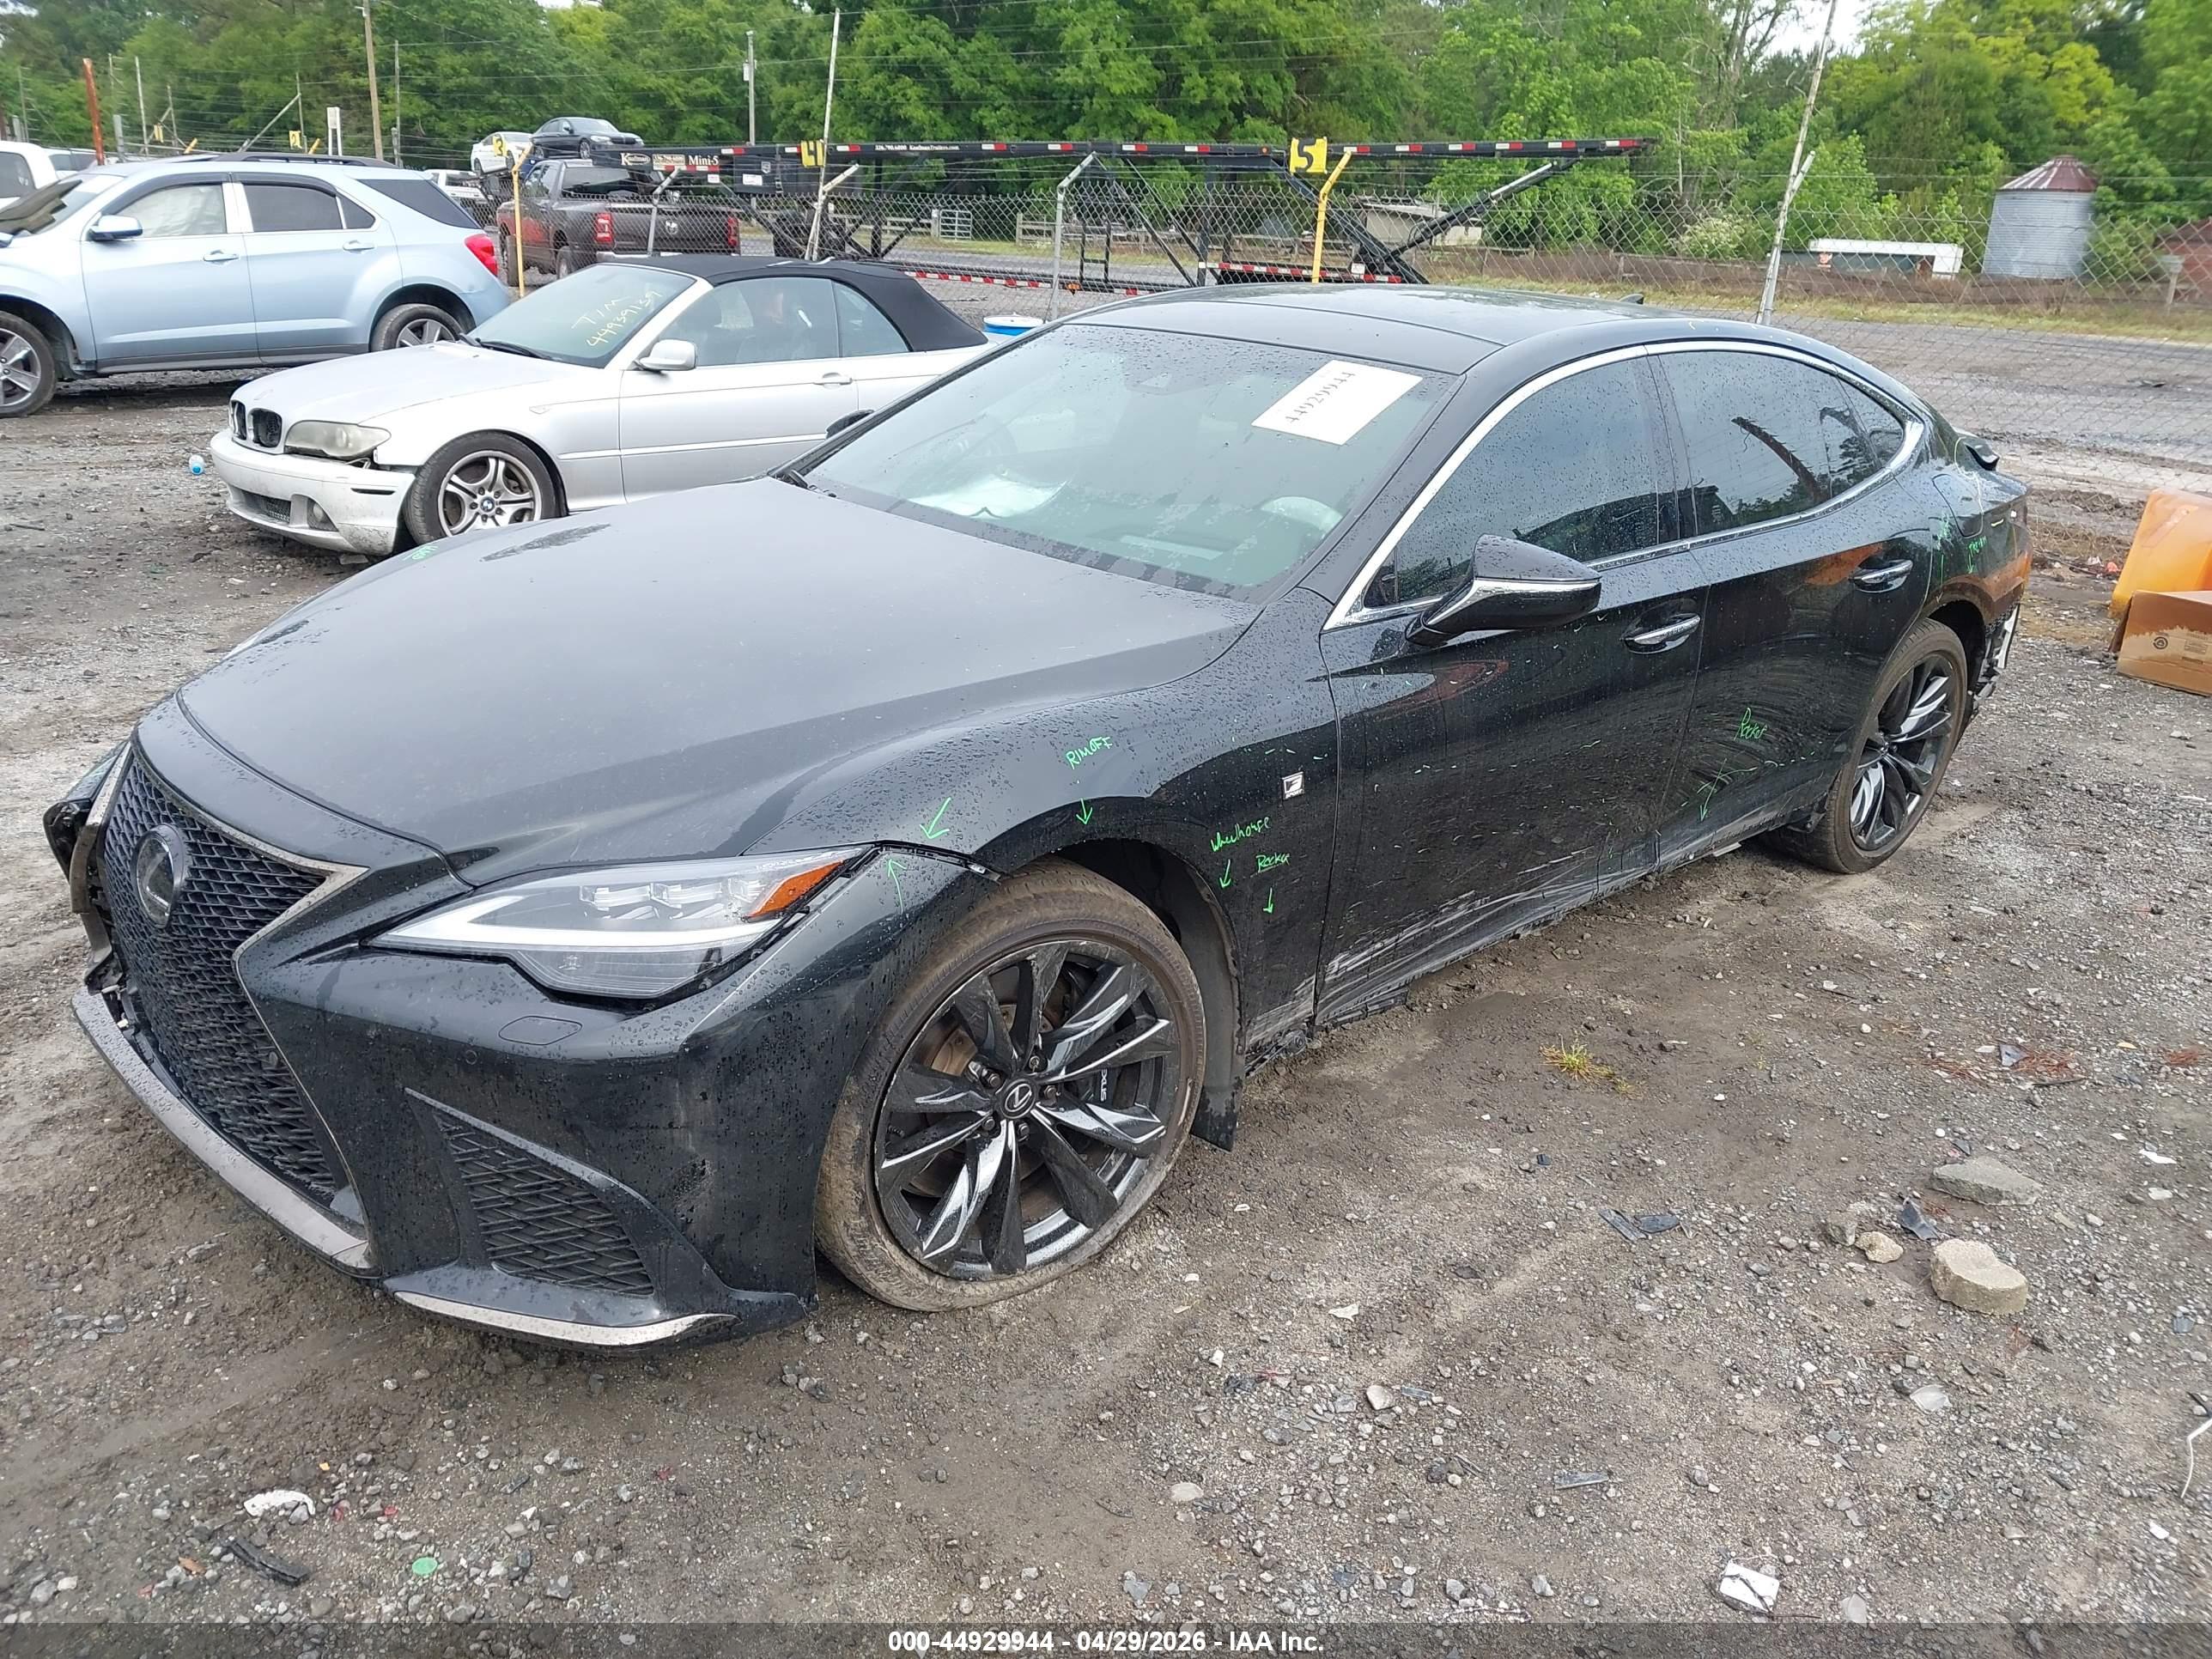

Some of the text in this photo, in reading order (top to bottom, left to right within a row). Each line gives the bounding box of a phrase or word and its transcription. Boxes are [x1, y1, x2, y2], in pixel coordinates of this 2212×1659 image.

[495, 137, 503, 156] 3
[806, 140, 817, 167] 4
[1295, 138, 1316, 173] 5
[621, 153, 651, 166] Kaufman
[688, 155, 719, 166] Mini-5
[1285, 371, 1356, 423] 44929944
